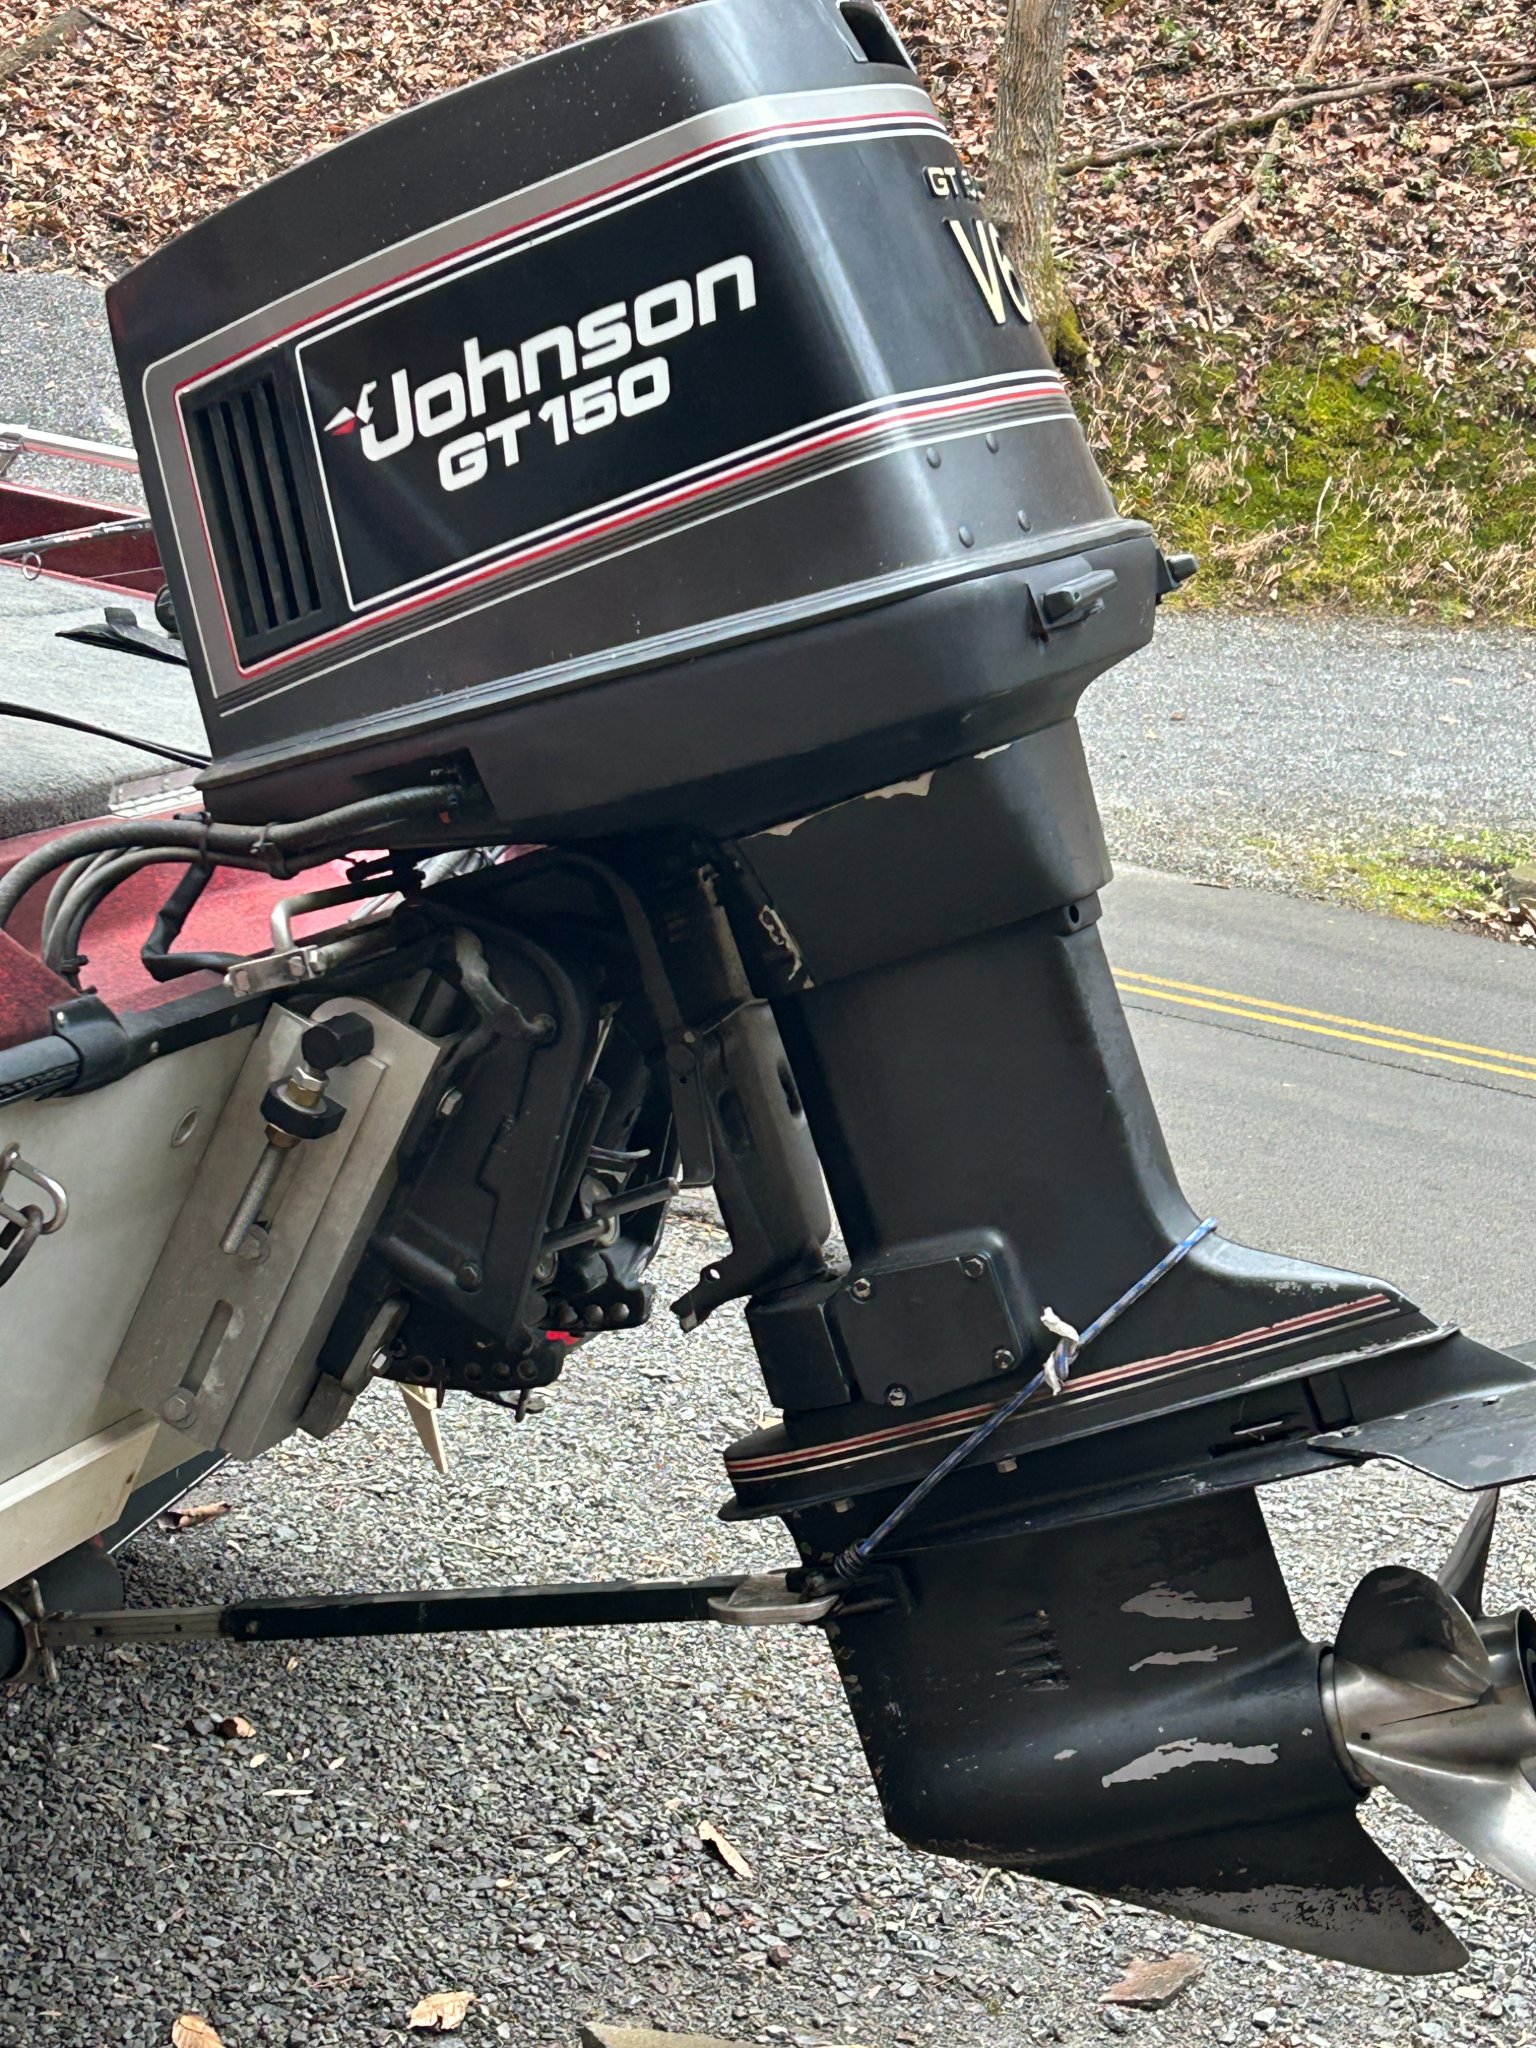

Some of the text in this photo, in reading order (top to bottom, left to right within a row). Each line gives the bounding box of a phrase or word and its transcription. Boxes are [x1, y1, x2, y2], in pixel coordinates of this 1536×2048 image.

[926, 166, 959, 197] GT
[946, 219, 1034, 325] V6
[358, 254, 757, 462] Johnson
[437, 355, 671, 492] GT 150
